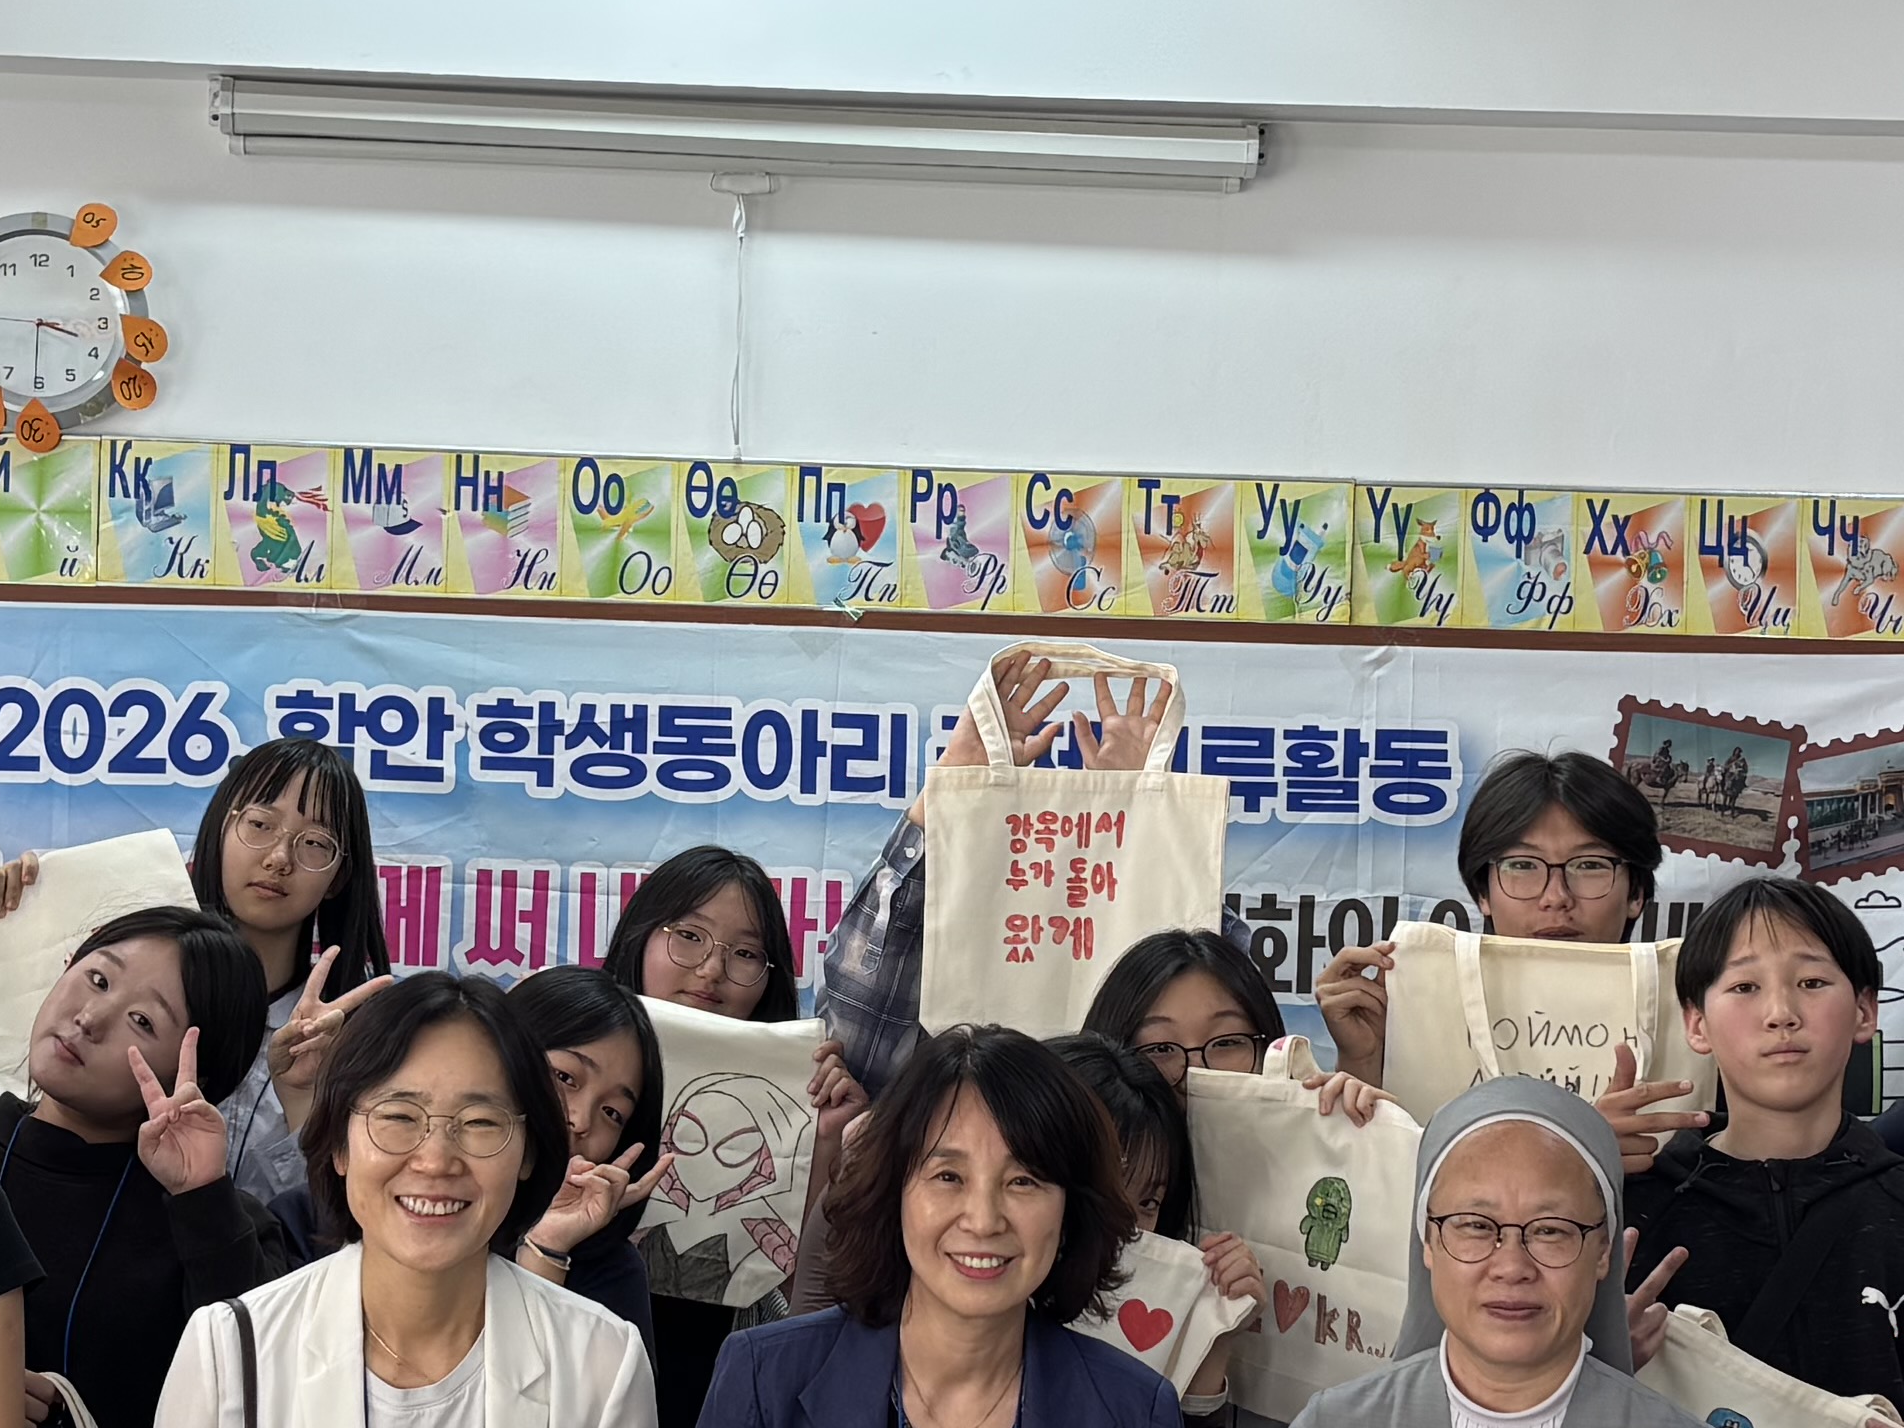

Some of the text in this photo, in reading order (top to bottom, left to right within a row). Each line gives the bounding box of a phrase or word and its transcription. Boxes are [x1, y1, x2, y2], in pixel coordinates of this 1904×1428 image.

[29, 254, 50, 267] 12
[0, 263, 17, 276] 11
[67, 265, 75, 278] 1
[89, 287, 100, 300] 2
[97, 317, 109, 330] 3
[88, 346, 99, 359] 4
[3, 366, 14, 380] 7
[65, 369, 76, 382] 5
[34, 376, 45, 389] 6
[108, 440, 152, 500] Кк
[224, 444, 277, 502] Лл
[342, 447, 402, 505] Мм
[456, 453, 503, 513] Нн
[572, 457, 625, 515] Оо
[685, 461, 739, 519] Өө
[797, 467, 846, 523] Пп
[910, 470, 957, 526] Рр
[1026, 473, 1073, 531] Сс
[1137, 478, 1181, 535] Тт
[1255, 483, 1299, 551] Уу
[1366, 487, 1413, 555] Үү
[1471, 489, 1535, 550] Фф
[1585, 498, 1630, 556] Хх
[1698, 498, 1748, 575] Цц
[1812, 501, 1859, 555] Чч
[618, 550, 672, 597] Оо
[475, 698, 907, 800] 학생동아리
[1005, 857, 1119, 908] 누가 돌아
[1003, 913, 1094, 963] 왔게
[1467, 1009, 1638, 1051] ОЙМОН
